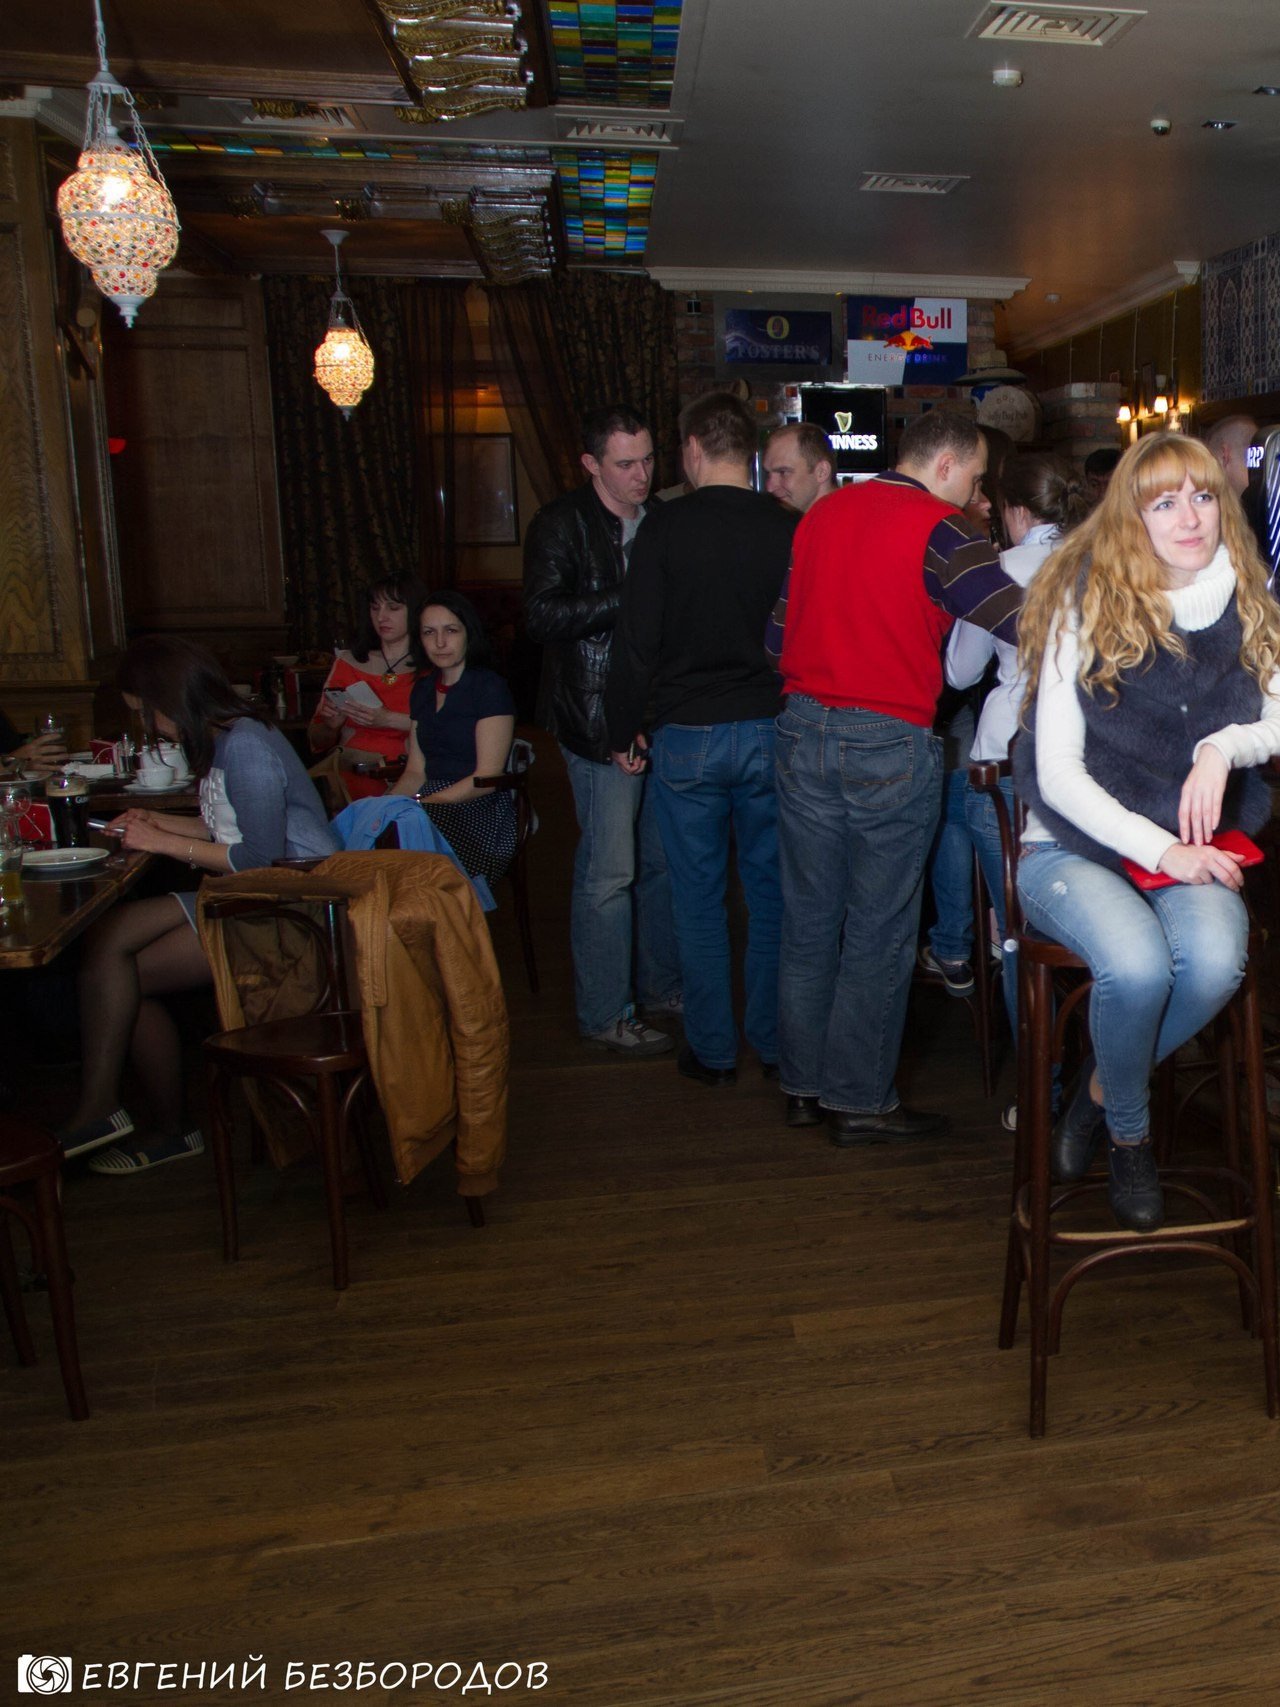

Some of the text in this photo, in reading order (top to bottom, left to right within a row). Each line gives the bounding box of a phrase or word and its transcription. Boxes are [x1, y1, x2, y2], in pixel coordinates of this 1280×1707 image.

[863, 304, 952, 330] Red Bull
[914, 353, 948, 363] DRINK
